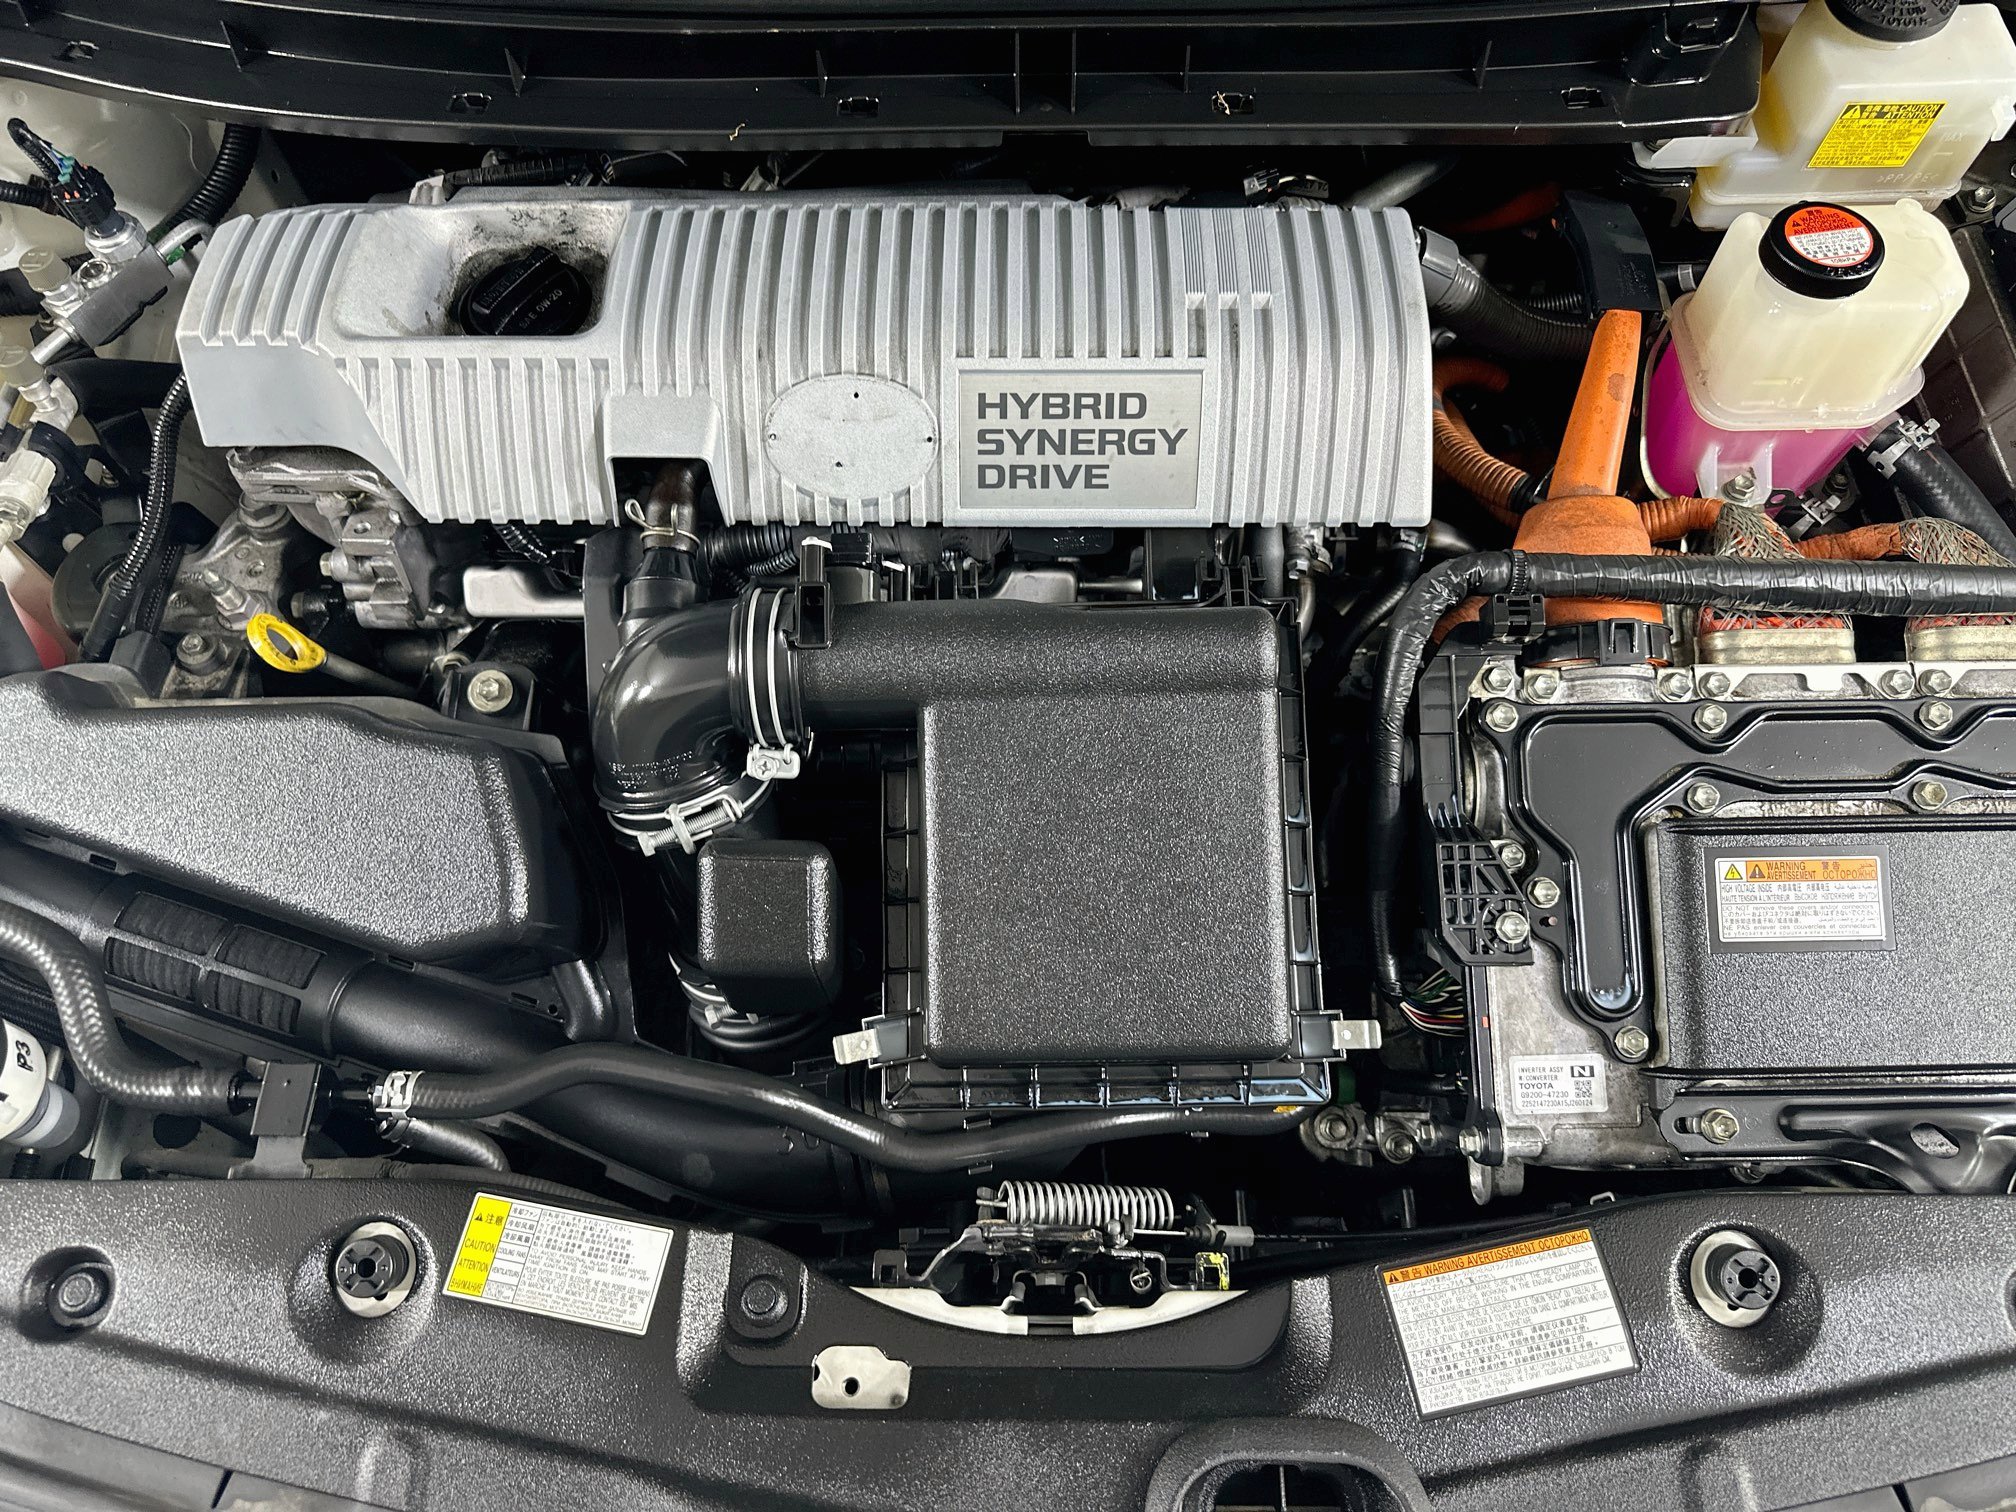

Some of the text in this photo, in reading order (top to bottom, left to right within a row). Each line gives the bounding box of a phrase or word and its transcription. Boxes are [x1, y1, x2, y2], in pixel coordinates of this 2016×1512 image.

[1800, 213, 1840, 223] WARNING
[1794, 222, 1854, 235] AVERTISSEMENT
[978, 392, 1147, 419] HYBRID
[977, 429, 1188, 455] SYNERGY
[978, 464, 1110, 489] DRIVE
[1765, 861, 1805, 870] WARNING
[1766, 870, 1816, 880] AVERTISSEMENT
[1721, 883, 1772, 893] HIGH VOLTAGE INSIDE
[15, 1039, 34, 1072] P3
[484, 1212, 504, 1226] 注意
[463, 1238, 496, 1253] CAUTION
[1537, 1230, 1588, 1250] ОСТОРОЖНО
[457, 1257, 490, 1273] ATTENTION
[1423, 1257, 1465, 1275] WARNING
[1465, 1242, 1534, 1266] AVERTISSEMENT
[1399, 1266, 1423, 1280] 警告
[1397, 1307, 1408, 1316] THE
[1410, 1302, 1431, 1313] METER
[1440, 1297, 1453, 1306] OFF
[1455, 1292, 1478, 1303] BEFORE
[1480, 1285, 1508, 1298] WORKING
[1518, 1280, 1530, 1290] THE
[1532, 1275, 1554, 1286] ENGINE
[1406, 1296, 1424, 1306] AVOID
[1450, 1285, 1473, 1296] PLEASE
[1474, 1281, 1492, 1291] MAKE
[1511, 1274, 1527, 1283] THAT
[1530, 1271, 1540, 1279] THE
[1467, 1299, 1480, 1308] FOR
